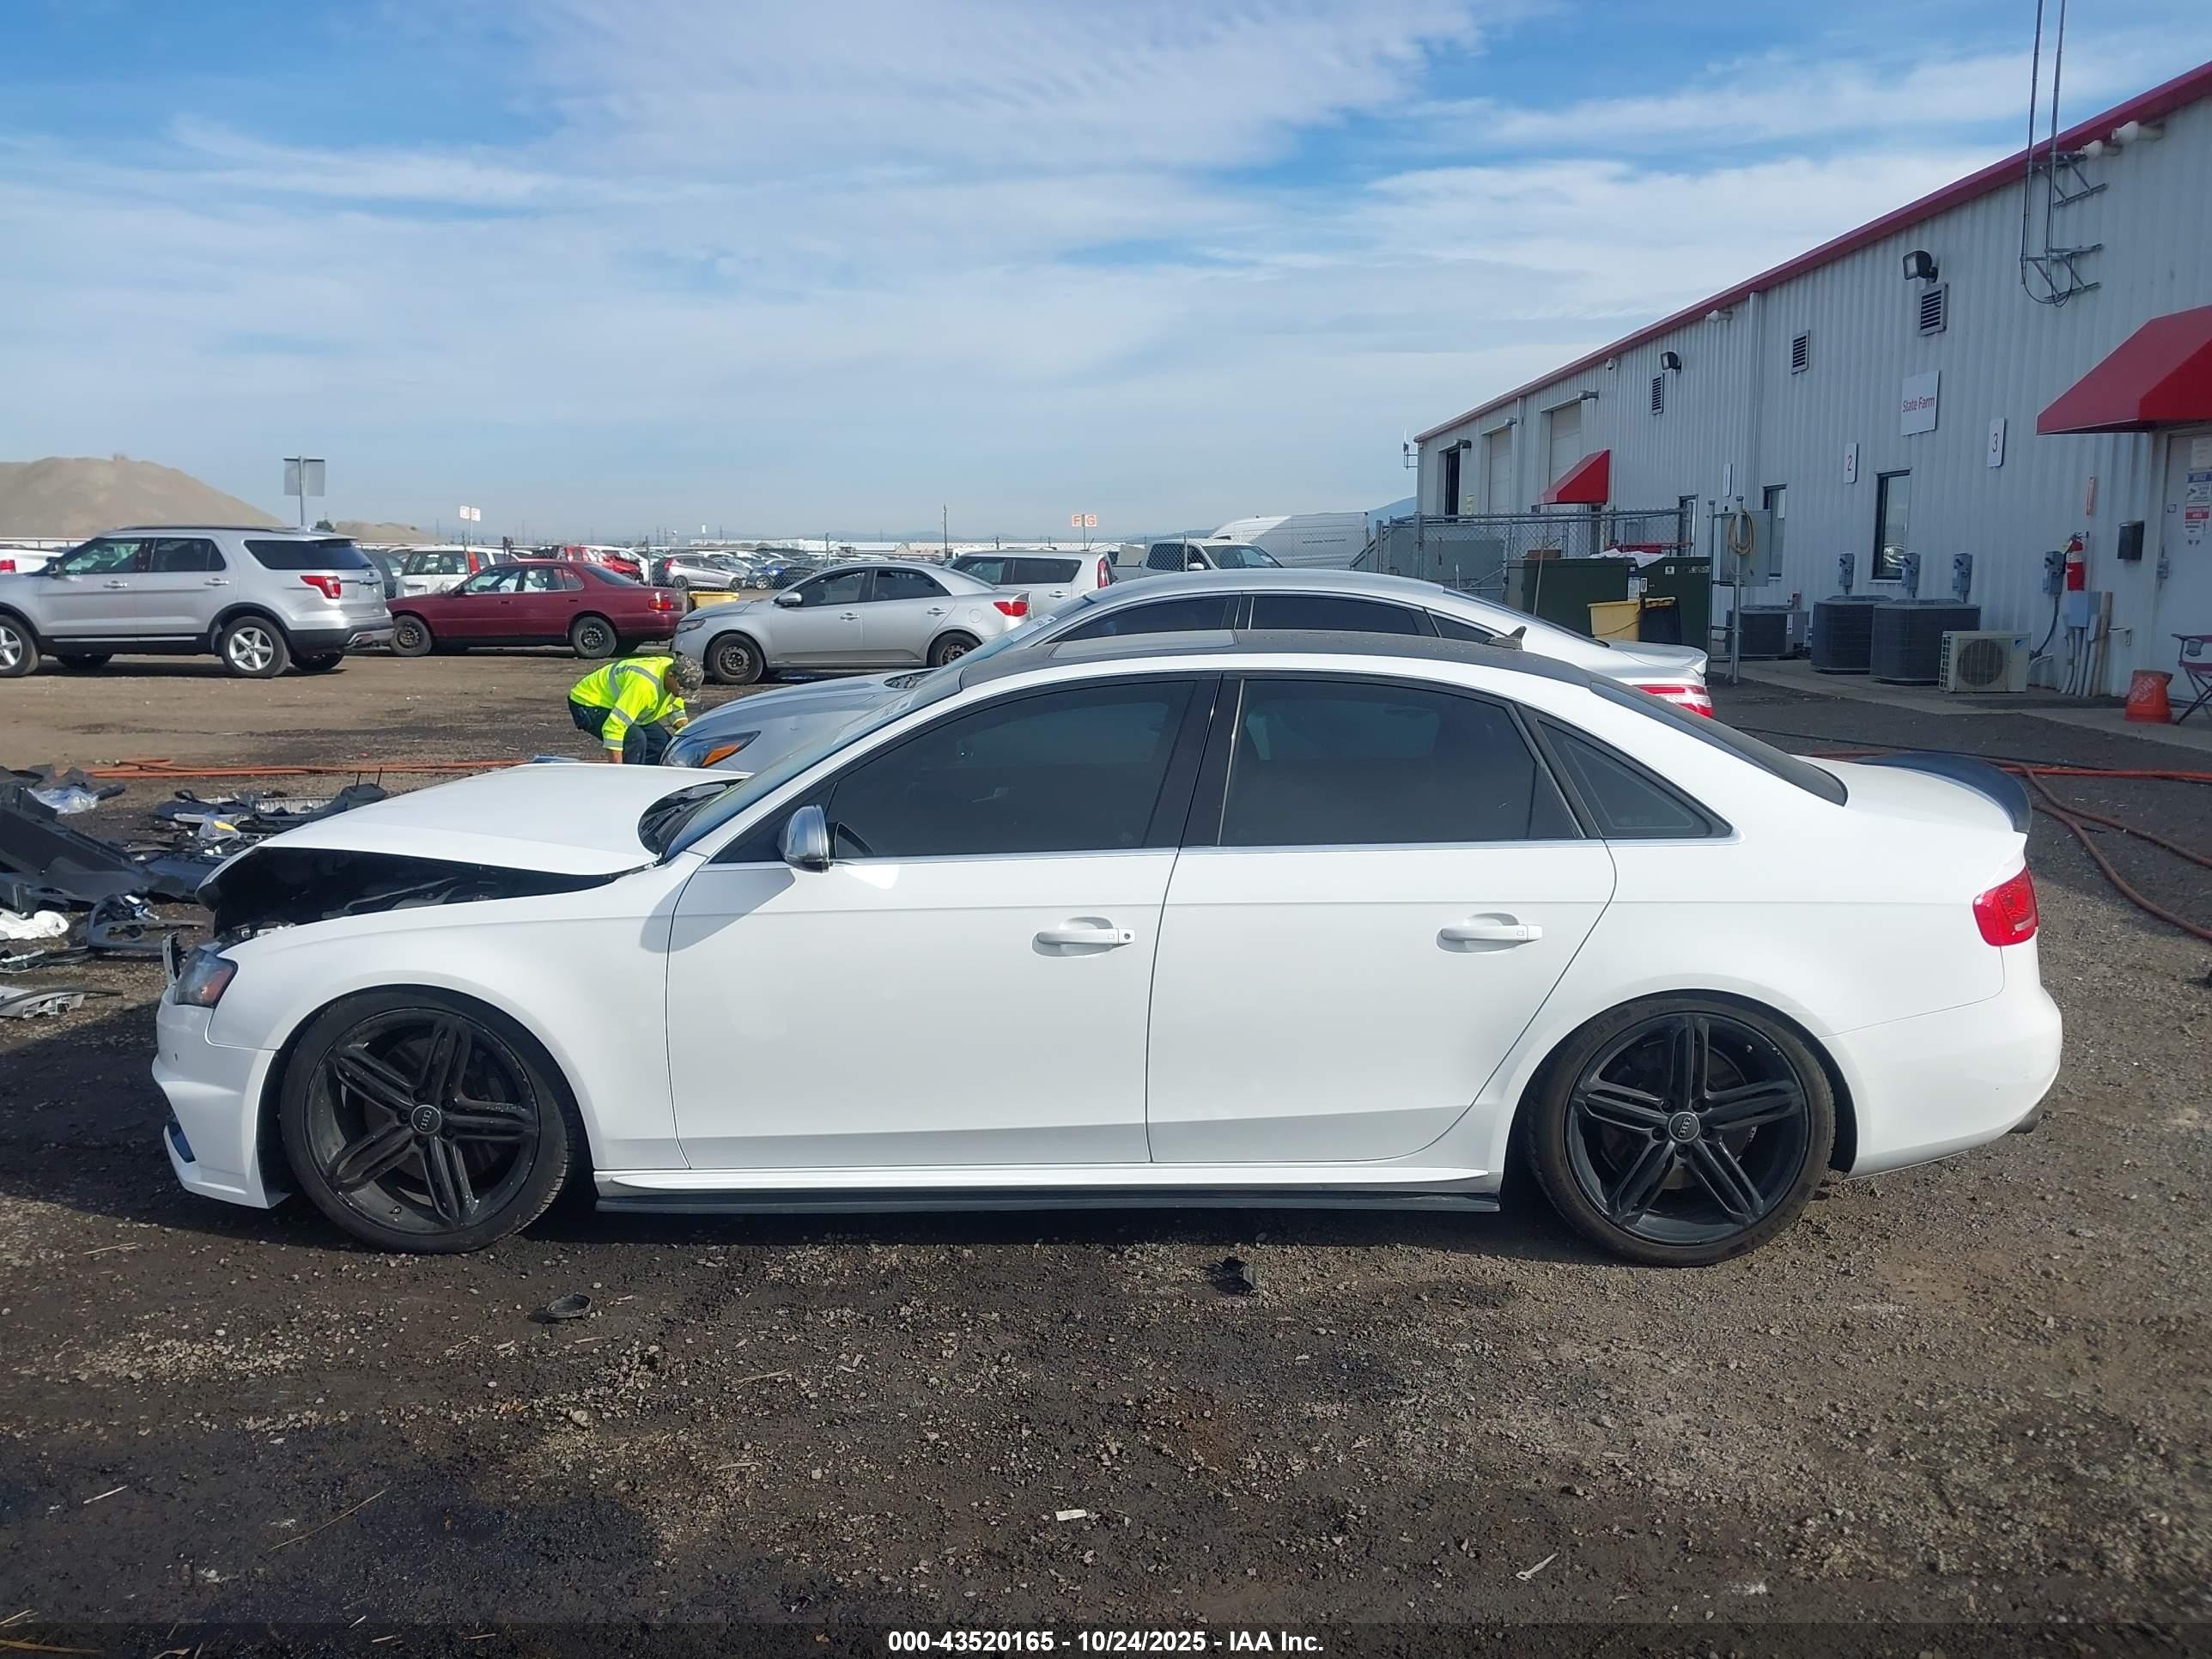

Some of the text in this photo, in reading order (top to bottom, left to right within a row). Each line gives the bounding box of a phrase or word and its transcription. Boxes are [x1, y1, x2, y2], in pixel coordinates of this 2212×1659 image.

[1902, 396, 1936, 413] State Farm
[1992, 432, 1998, 453] 3
[1847, 454, 1853, 471] 2
[1073, 515, 1081, 525] F
[1086, 515, 1096, 526] G
